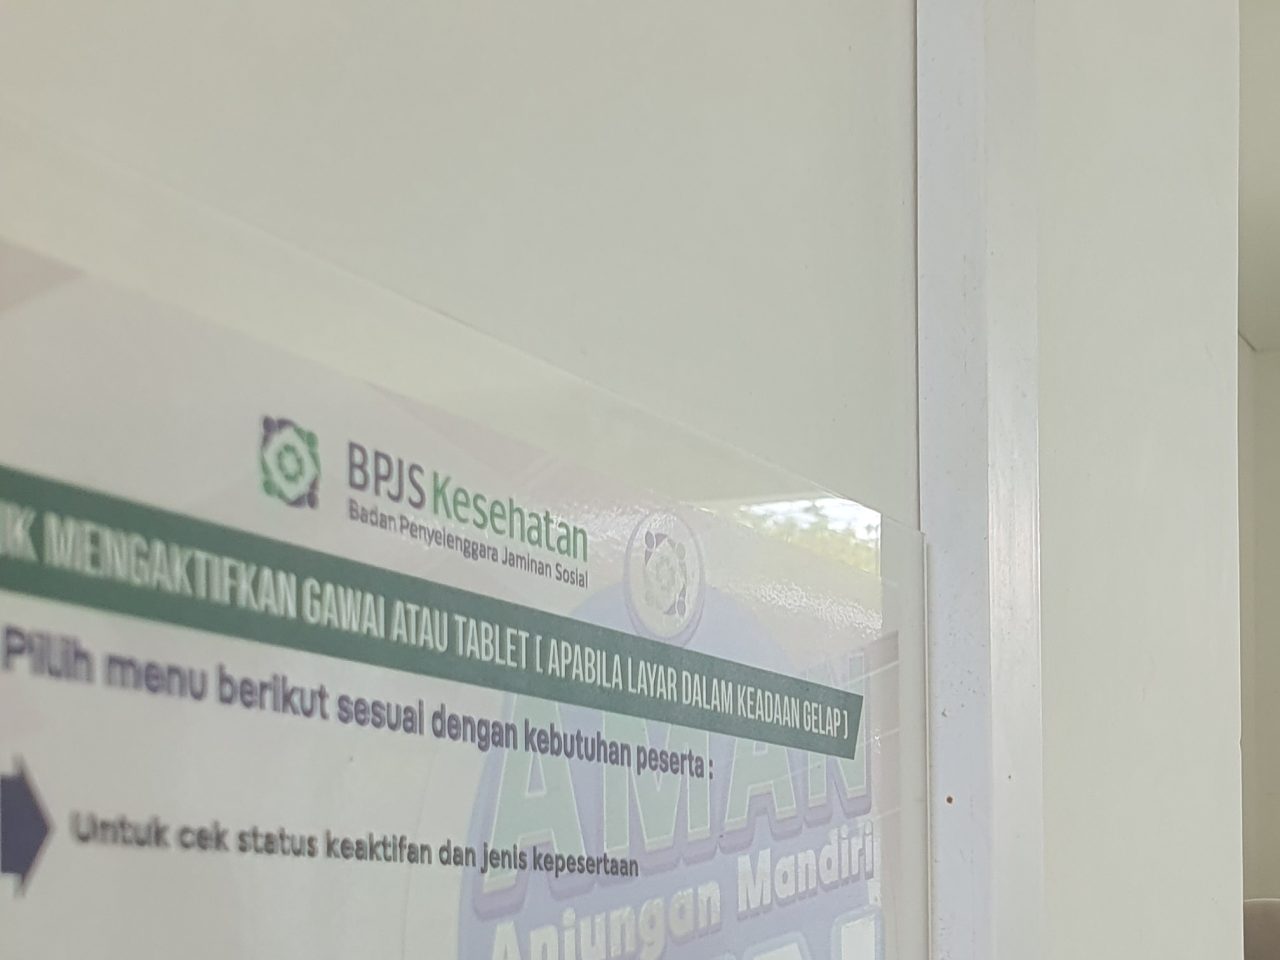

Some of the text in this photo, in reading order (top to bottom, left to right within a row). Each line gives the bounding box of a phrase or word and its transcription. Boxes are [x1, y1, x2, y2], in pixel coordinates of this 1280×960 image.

[347, 441, 589, 562] BPJS Kesehatan
[347, 499, 589, 590] Badan Penyelenggara Jaminan Sosial
[42, 512, 296, 619] MENGAKTIFKAN
[303, 576, 385, 638] GAWAI
[391, 599, 448, 653] ATAU
[454, 614, 530, 669] TABLET
[548, 637, 623, 691] APABILA
[628, 657, 678, 702] LAYAR
[682, 670, 733, 715] DALAM
[737, 684, 800, 729] KEADAAN
[803, 700, 841, 738] GELAP
[3, 625, 94, 684] Pilih
[104, 653, 208, 700] menu
[218, 664, 329, 720] berikut
[337, 692, 424, 735] sesuai
[431, 702, 518, 752] dengan
[525, 718, 631, 768] kebutuhan
[636, 741, 705, 778] peserta
[70, 810, 639, 878] Untuk cek status keaktifan dan jenis kepesertaan
[737, 821, 875, 913] Mandiri
